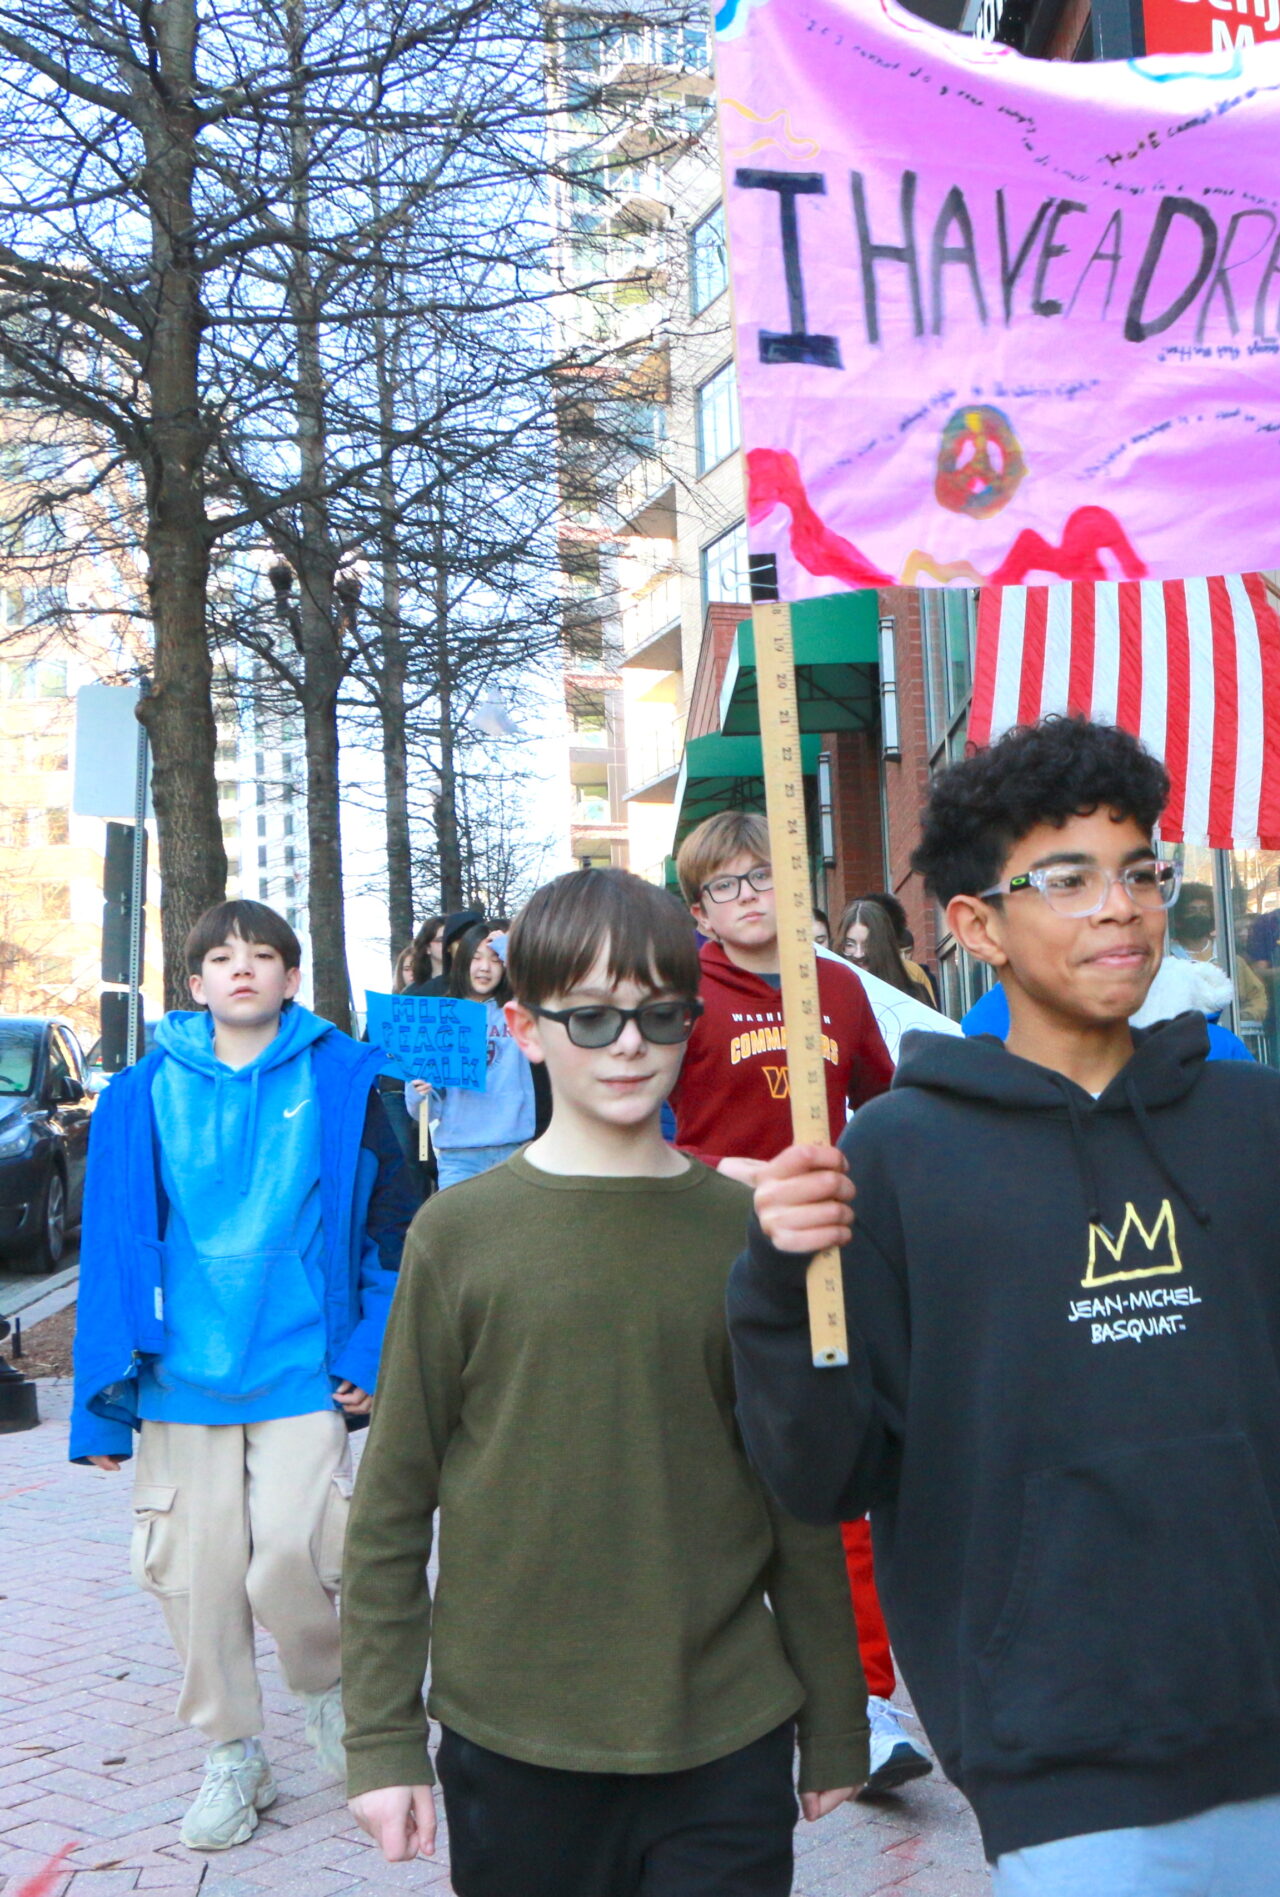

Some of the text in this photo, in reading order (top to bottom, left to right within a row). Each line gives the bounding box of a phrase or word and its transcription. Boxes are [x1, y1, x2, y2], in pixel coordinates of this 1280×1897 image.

[733, 167, 845, 371] I
[851, 170, 1087, 346] HAVE
[1064, 208, 1123, 323] A
[777, 673, 788, 689] 20
[782, 747, 792, 762] 22
[391, 997, 461, 1024] MLK
[732, 1012, 831, 1025] WASHIN
[381, 1021, 472, 1054] PEACE
[731, 1026, 839, 1066] COMMRS
[1068, 1285, 1202, 1322] JEAN-MICHEL
